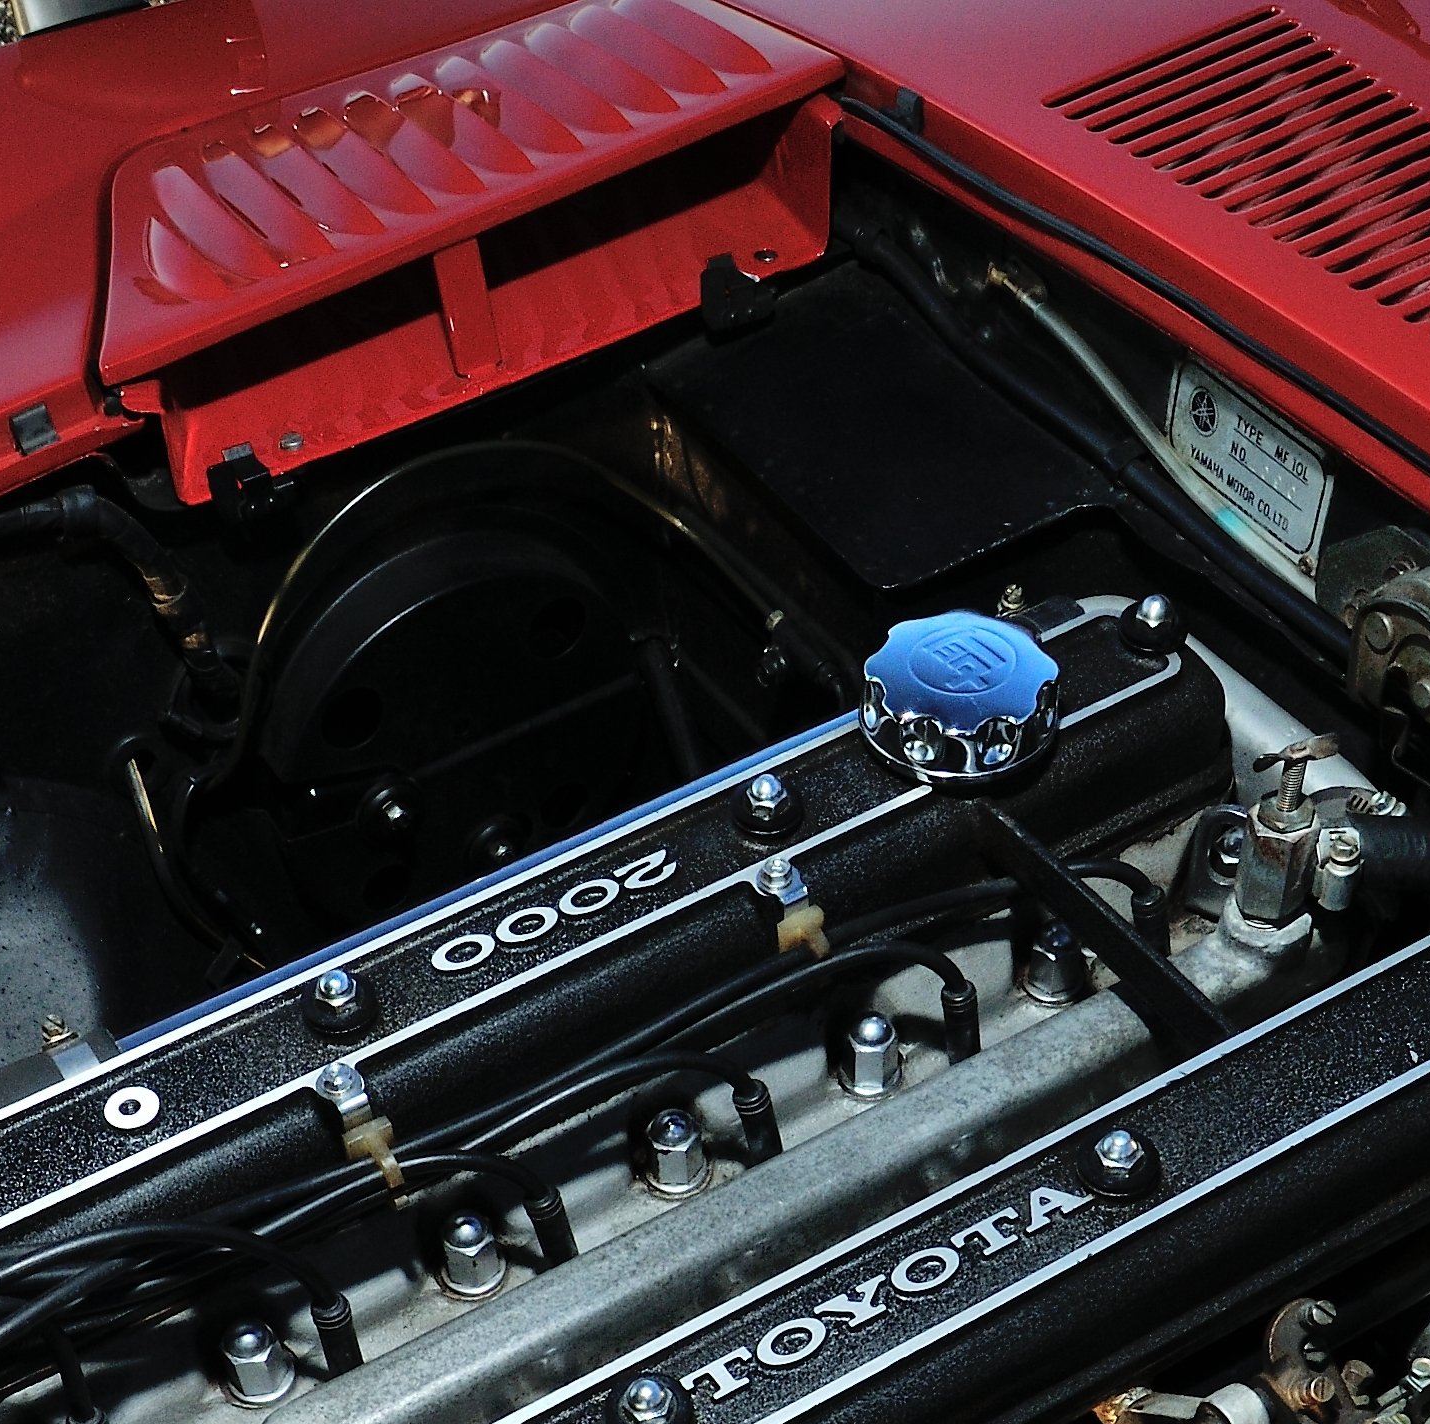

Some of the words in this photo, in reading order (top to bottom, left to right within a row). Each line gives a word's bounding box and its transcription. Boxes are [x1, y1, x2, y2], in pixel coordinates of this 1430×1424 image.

[1230, 440, 1249, 464] NO.
[1237, 414, 1264, 445] TYPE
[1190, 444, 1224, 481] YAMAHA
[1226, 473, 1255, 506] MOTOR
[431, 848, 677, 971] 2000
[681, 1186, 1093, 1400] TOYOTA
